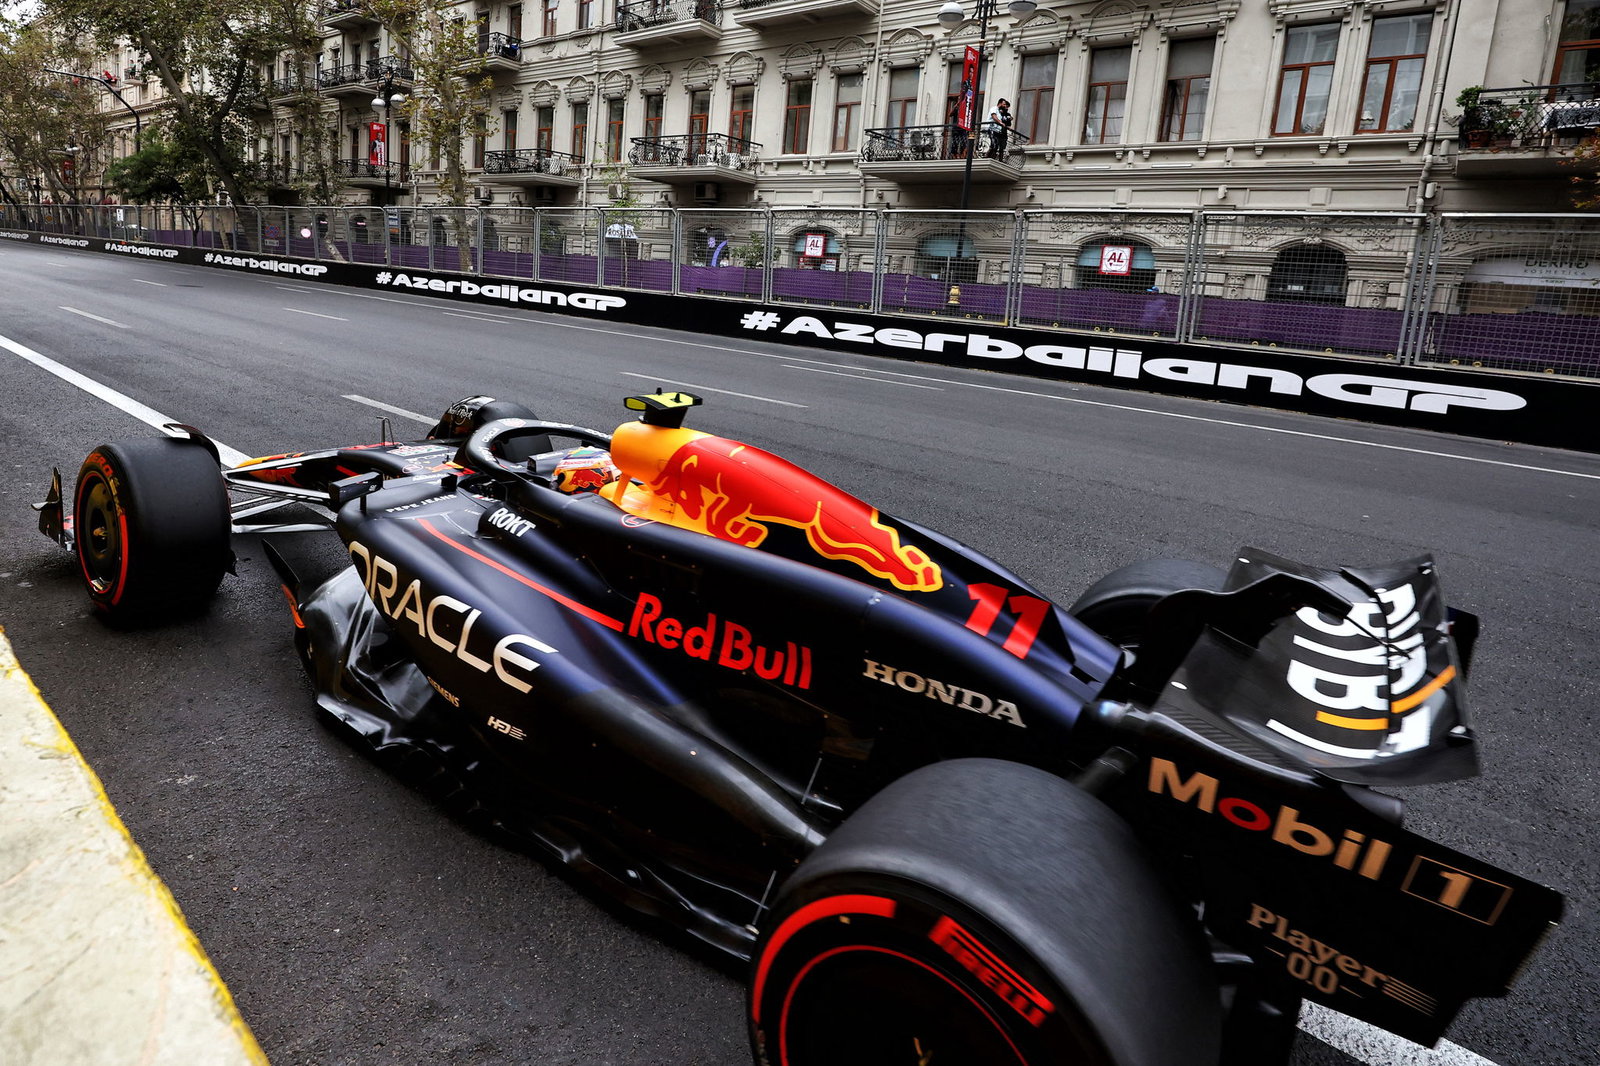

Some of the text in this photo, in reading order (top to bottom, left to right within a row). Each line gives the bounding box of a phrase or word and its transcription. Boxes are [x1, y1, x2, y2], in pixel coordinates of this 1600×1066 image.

[104, 242, 179, 258] #AzerbaijanGP
[204, 252, 328, 276] #AzerbaijanGP
[809, 239, 820, 248] AL
[1107, 252, 1124, 263] AL
[375, 271, 627, 311] #AzerbaijanGP
[740, 310, 1527, 414] #AzerbaijanGP
[488, 507, 537, 537] ROKT
[349, 540, 559, 694] ORACLE
[628, 592, 812, 690] Red Bull
[965, 583, 1051, 660] 11
[863, 659, 1027, 729] HONDA
[1148, 757, 1475, 909] Mobil 1
[1246, 902, 1389, 988] Player
